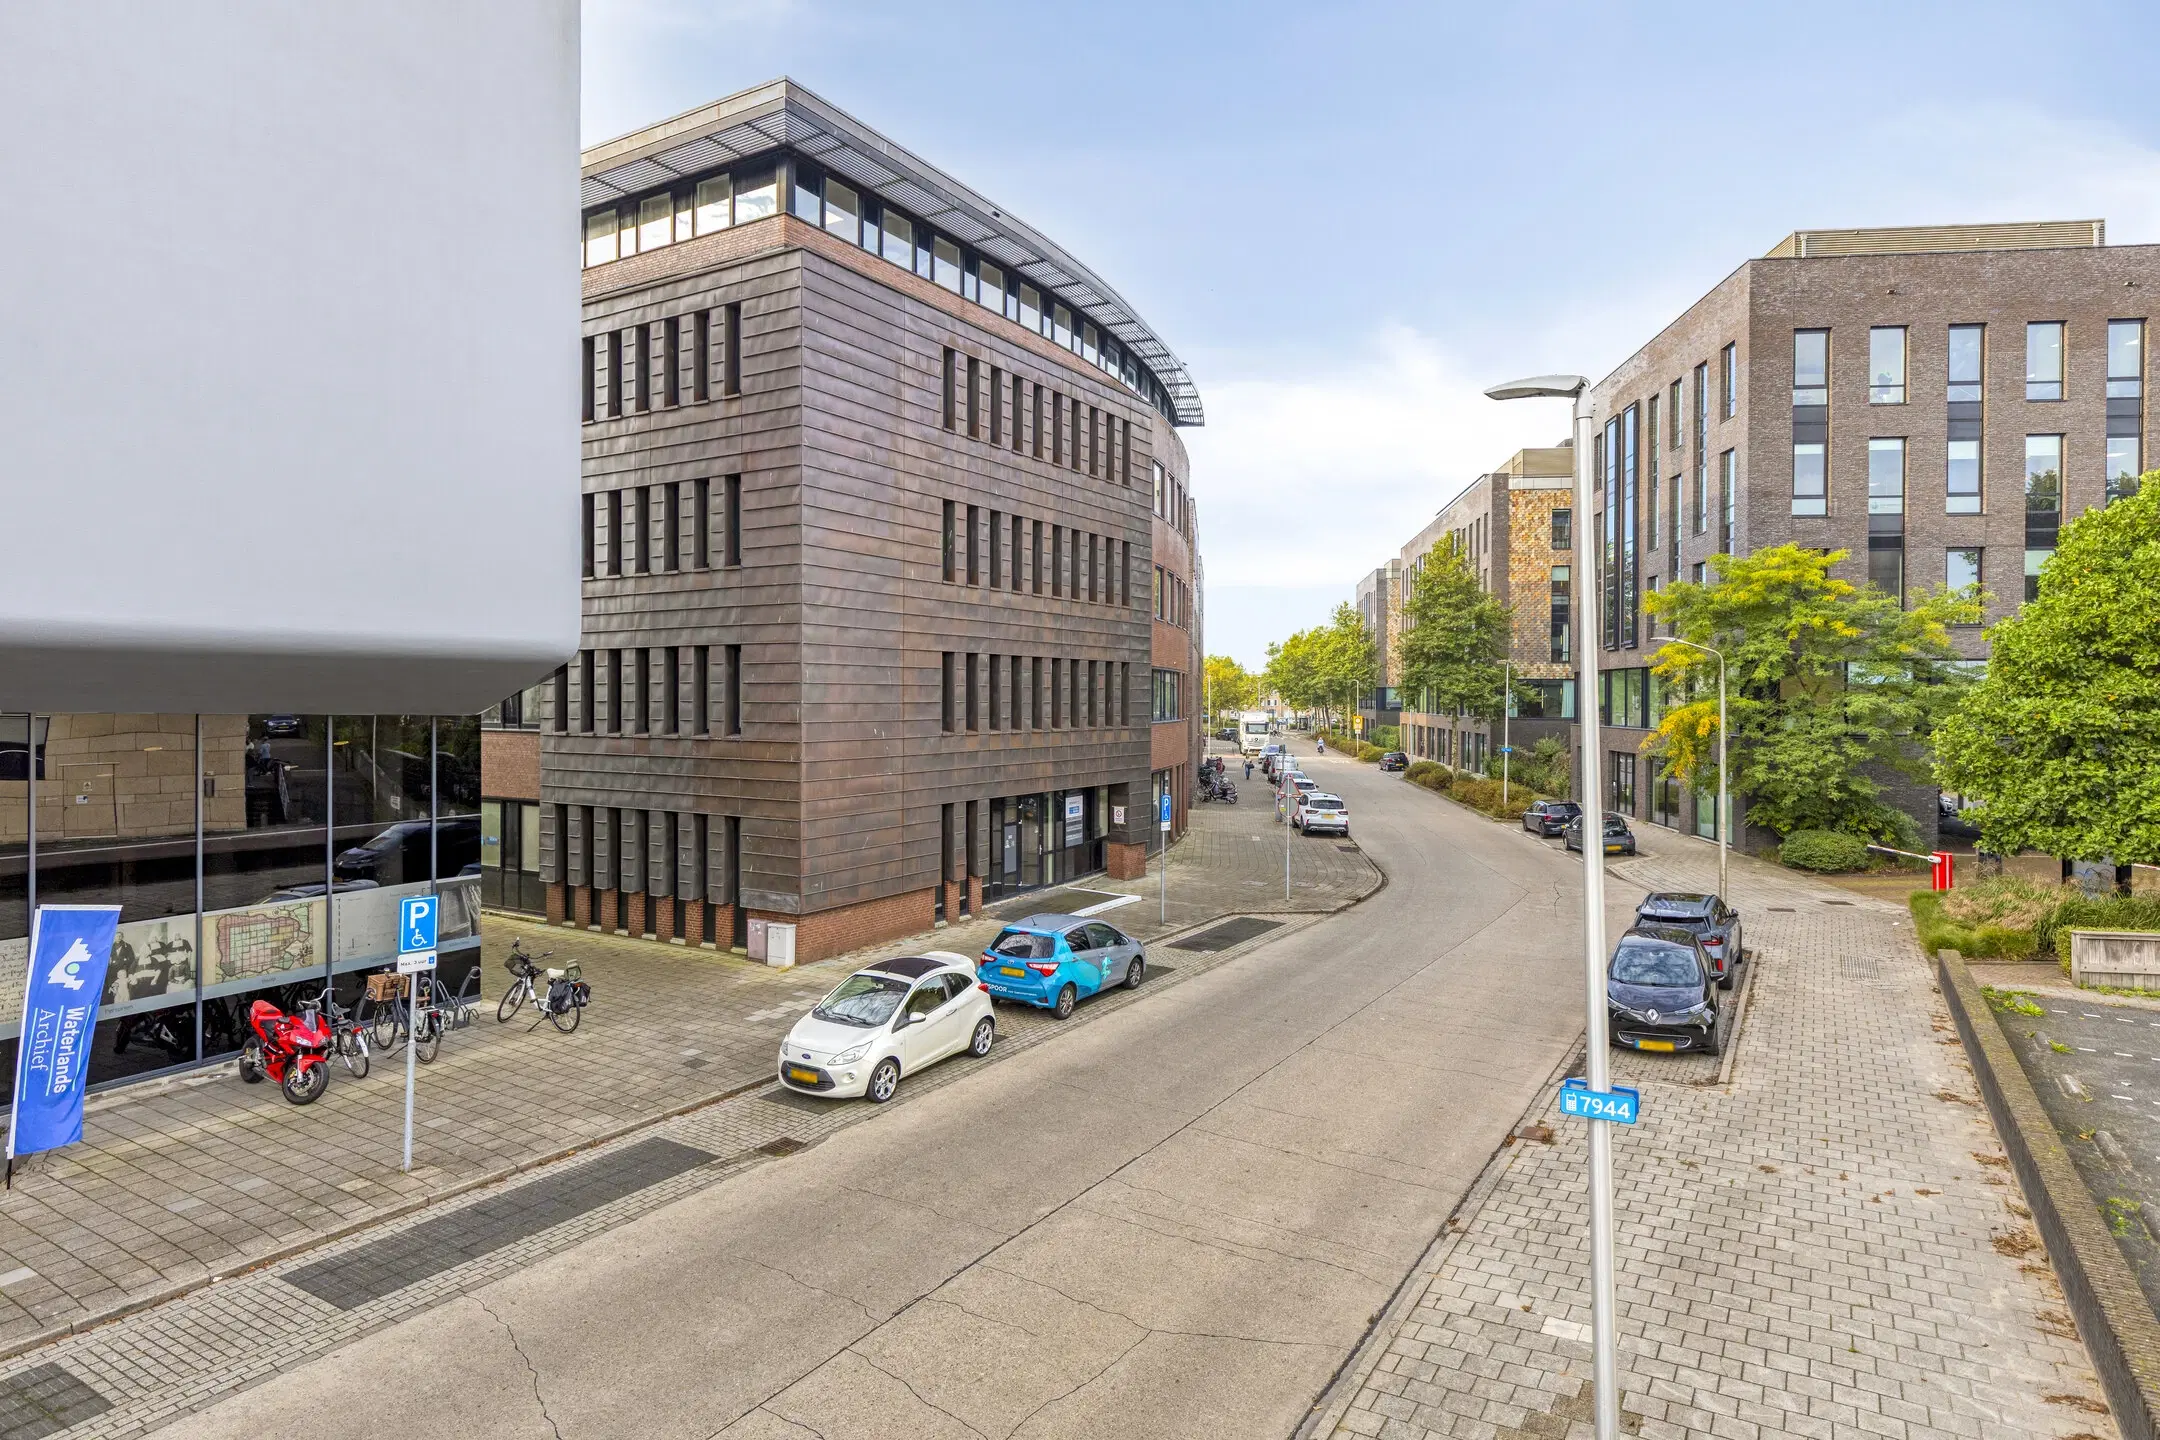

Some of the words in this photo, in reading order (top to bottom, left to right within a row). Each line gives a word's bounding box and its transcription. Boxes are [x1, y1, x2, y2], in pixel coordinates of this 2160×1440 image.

[1164, 798, 1169, 810] P
[410, 902, 430, 929] P
[30, 1009, 56, 1072] Archief
[54, 1006, 86, 1094] Waterlands
[1580, 1096, 1630, 1119] 7944
